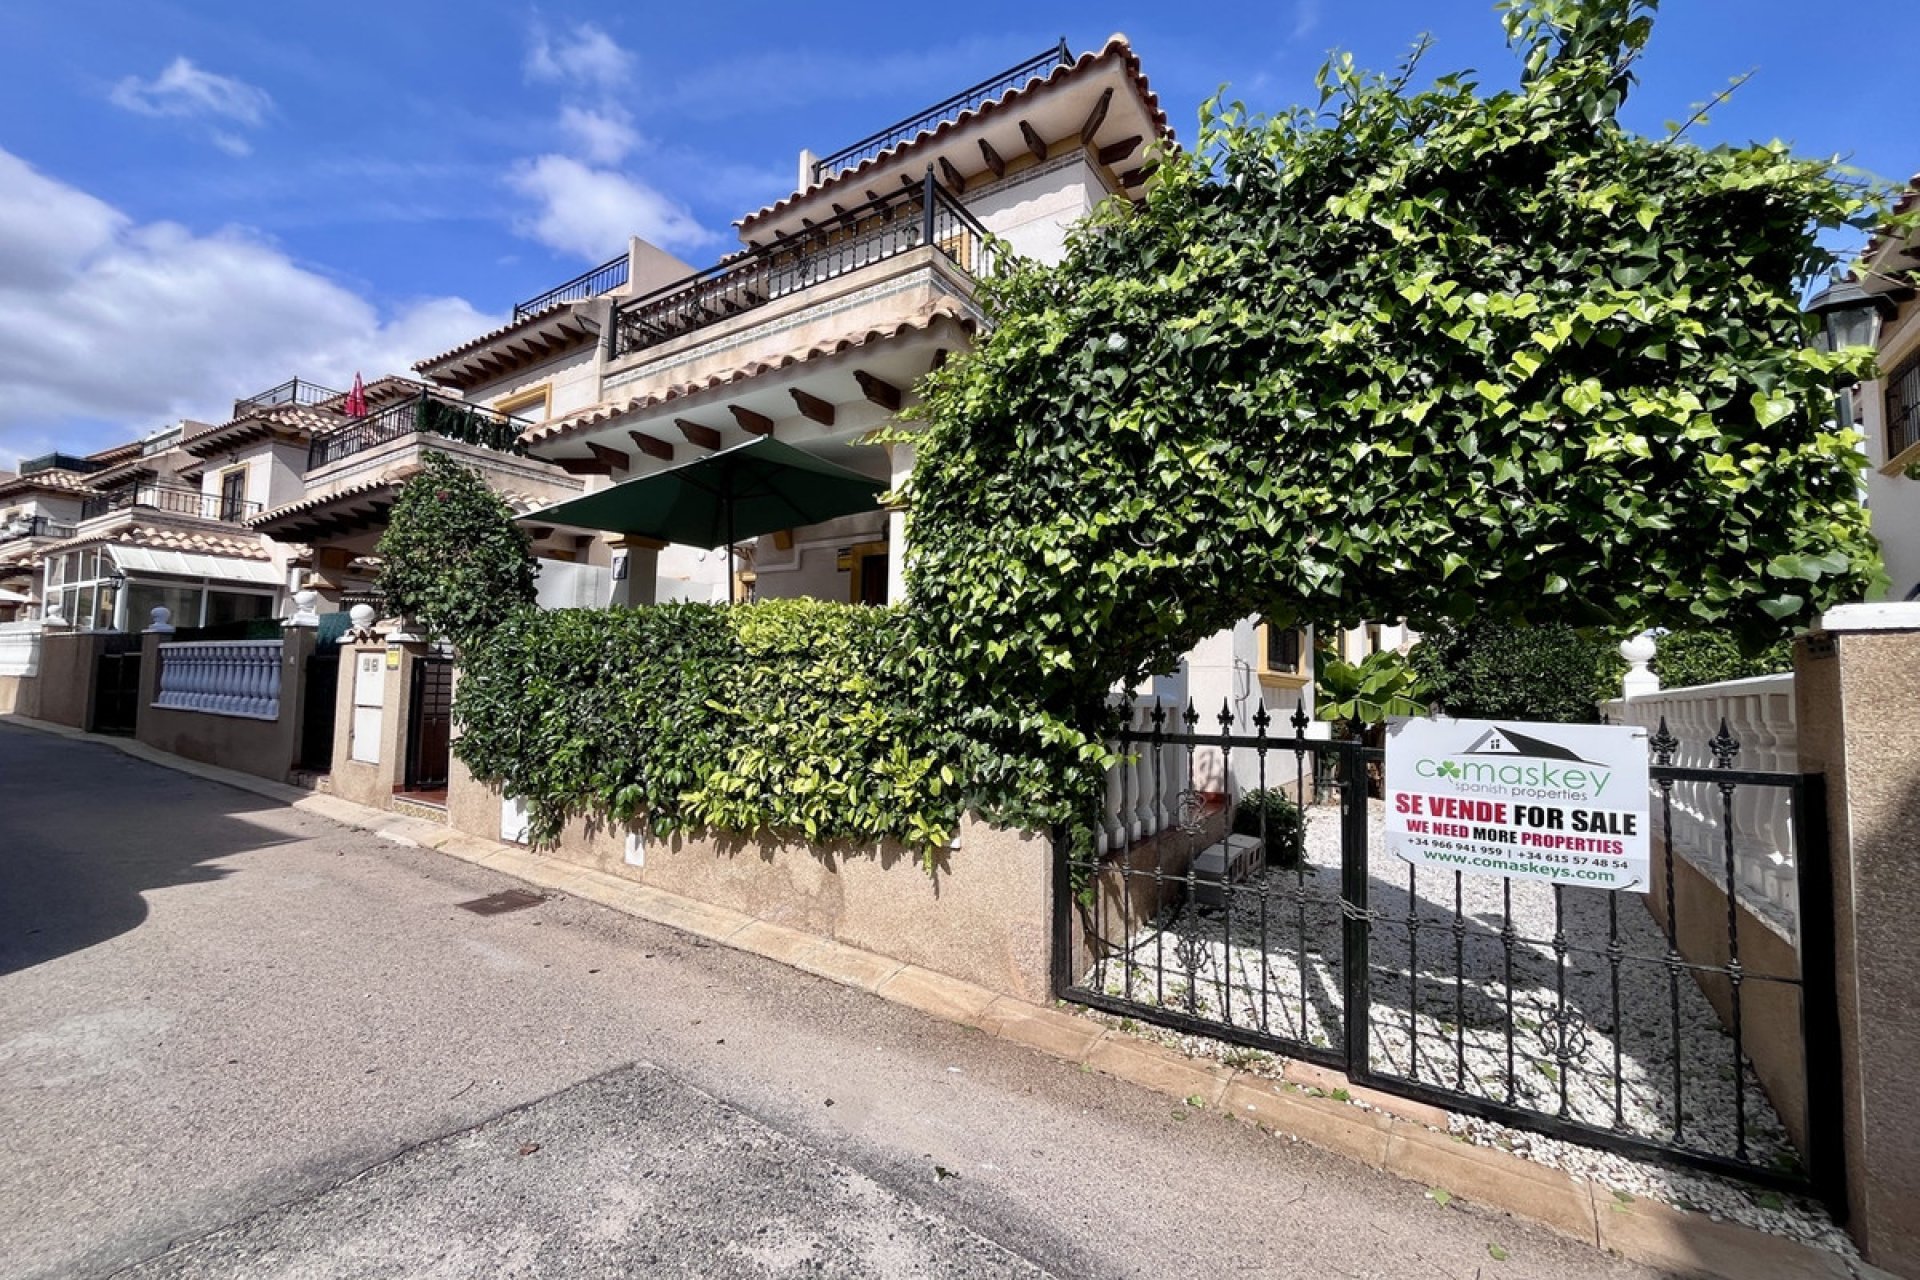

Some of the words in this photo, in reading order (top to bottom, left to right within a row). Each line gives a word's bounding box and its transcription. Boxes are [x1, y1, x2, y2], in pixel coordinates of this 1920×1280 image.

[1455, 783, 1508, 794] spanish
[1511, 787, 1588, 800] properties
[1395, 793, 1423, 815] SE
[1428, 796, 1507, 825] VENDE
[1514, 804, 1564, 830] FOR
[1571, 809, 1637, 836] SALE
[1406, 819, 1429, 834] WE
[1432, 822, 1469, 839] NEED
[1473, 826, 1518, 844] MORE
[1521, 832, 1623, 855] PROPERTIES
[1408, 837, 1429, 846] +34
[1432, 840, 1453, 850] 966
[1456, 842, 1476, 853] 941
[1480, 846, 1503, 856] 959
[1517, 851, 1541, 860] +34
[1545, 854, 1569, 863] 615
[1572, 855, 1588, 865] 57
[1592, 858, 1609, 868] 48
[1612, 860, 1628, 869] 54
[1423, 850, 1615, 882] www.comaskeys.com
